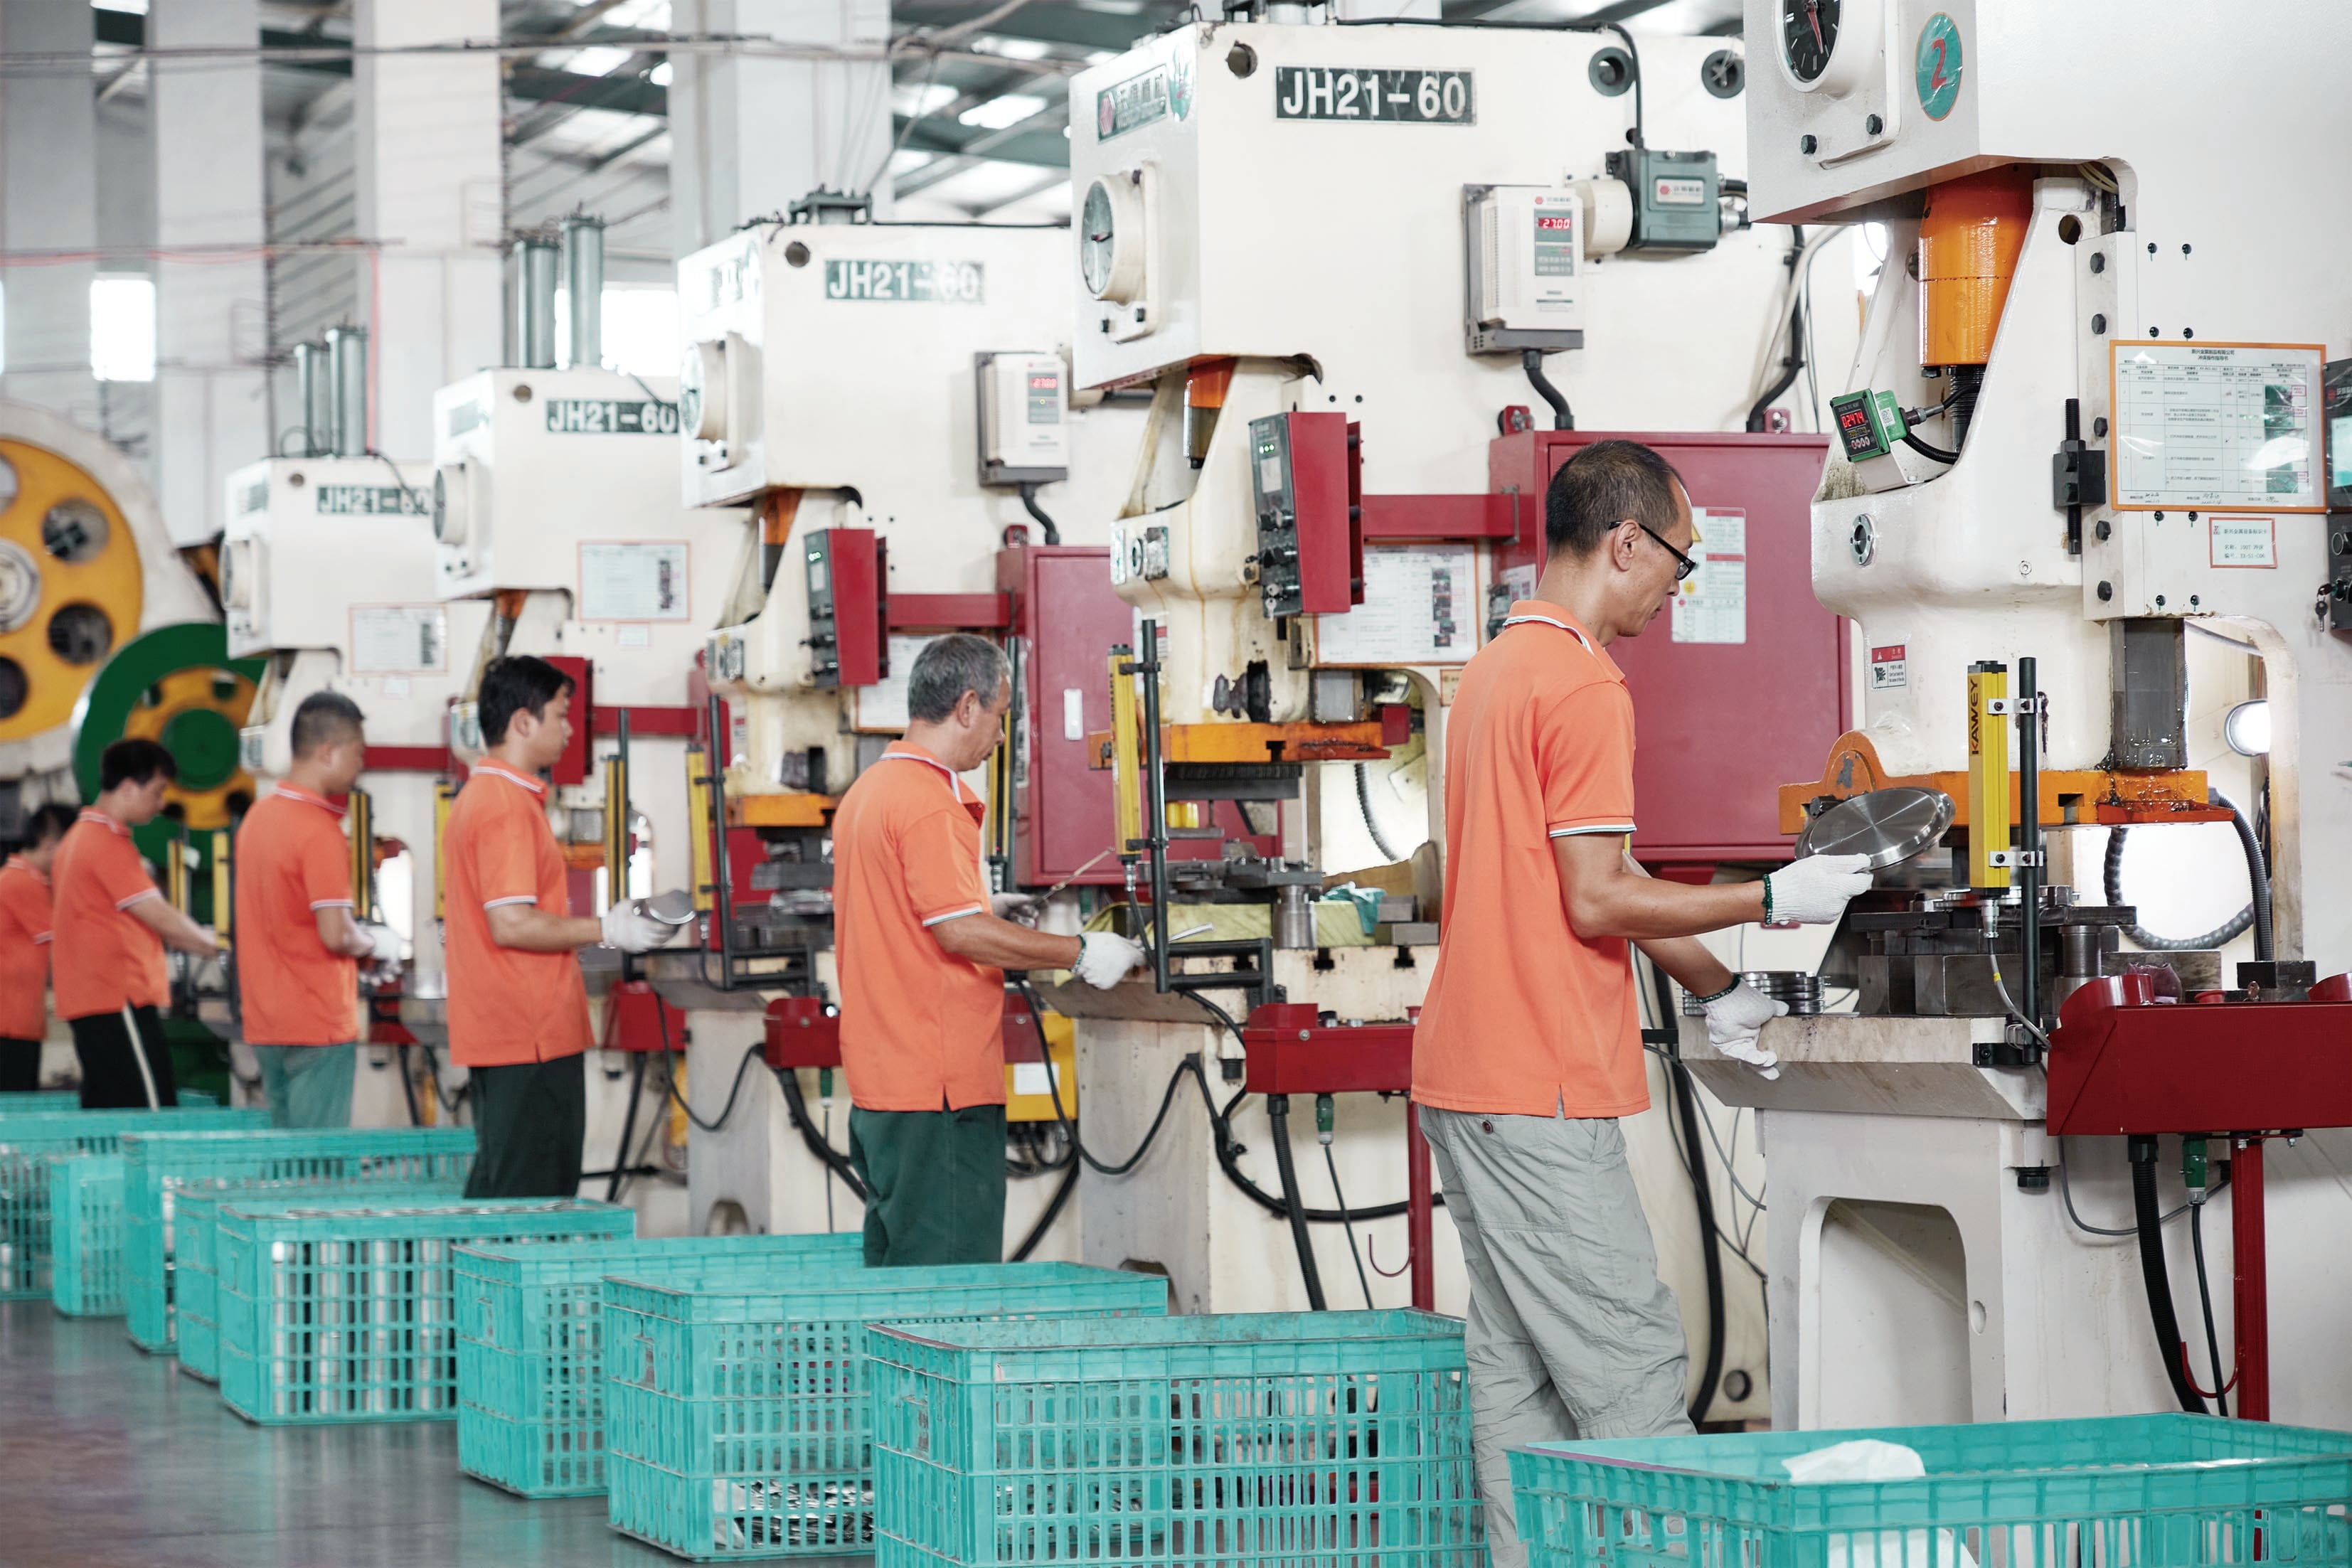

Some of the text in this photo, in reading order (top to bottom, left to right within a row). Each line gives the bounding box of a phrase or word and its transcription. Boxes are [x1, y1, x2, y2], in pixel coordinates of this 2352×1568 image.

[1930, 38, 1947, 90] 2
[1282, 70, 1467, 118] JH21-60
[829, 260, 979, 299] JH21-60
[1970, 678, 1979, 754] KAWEY
